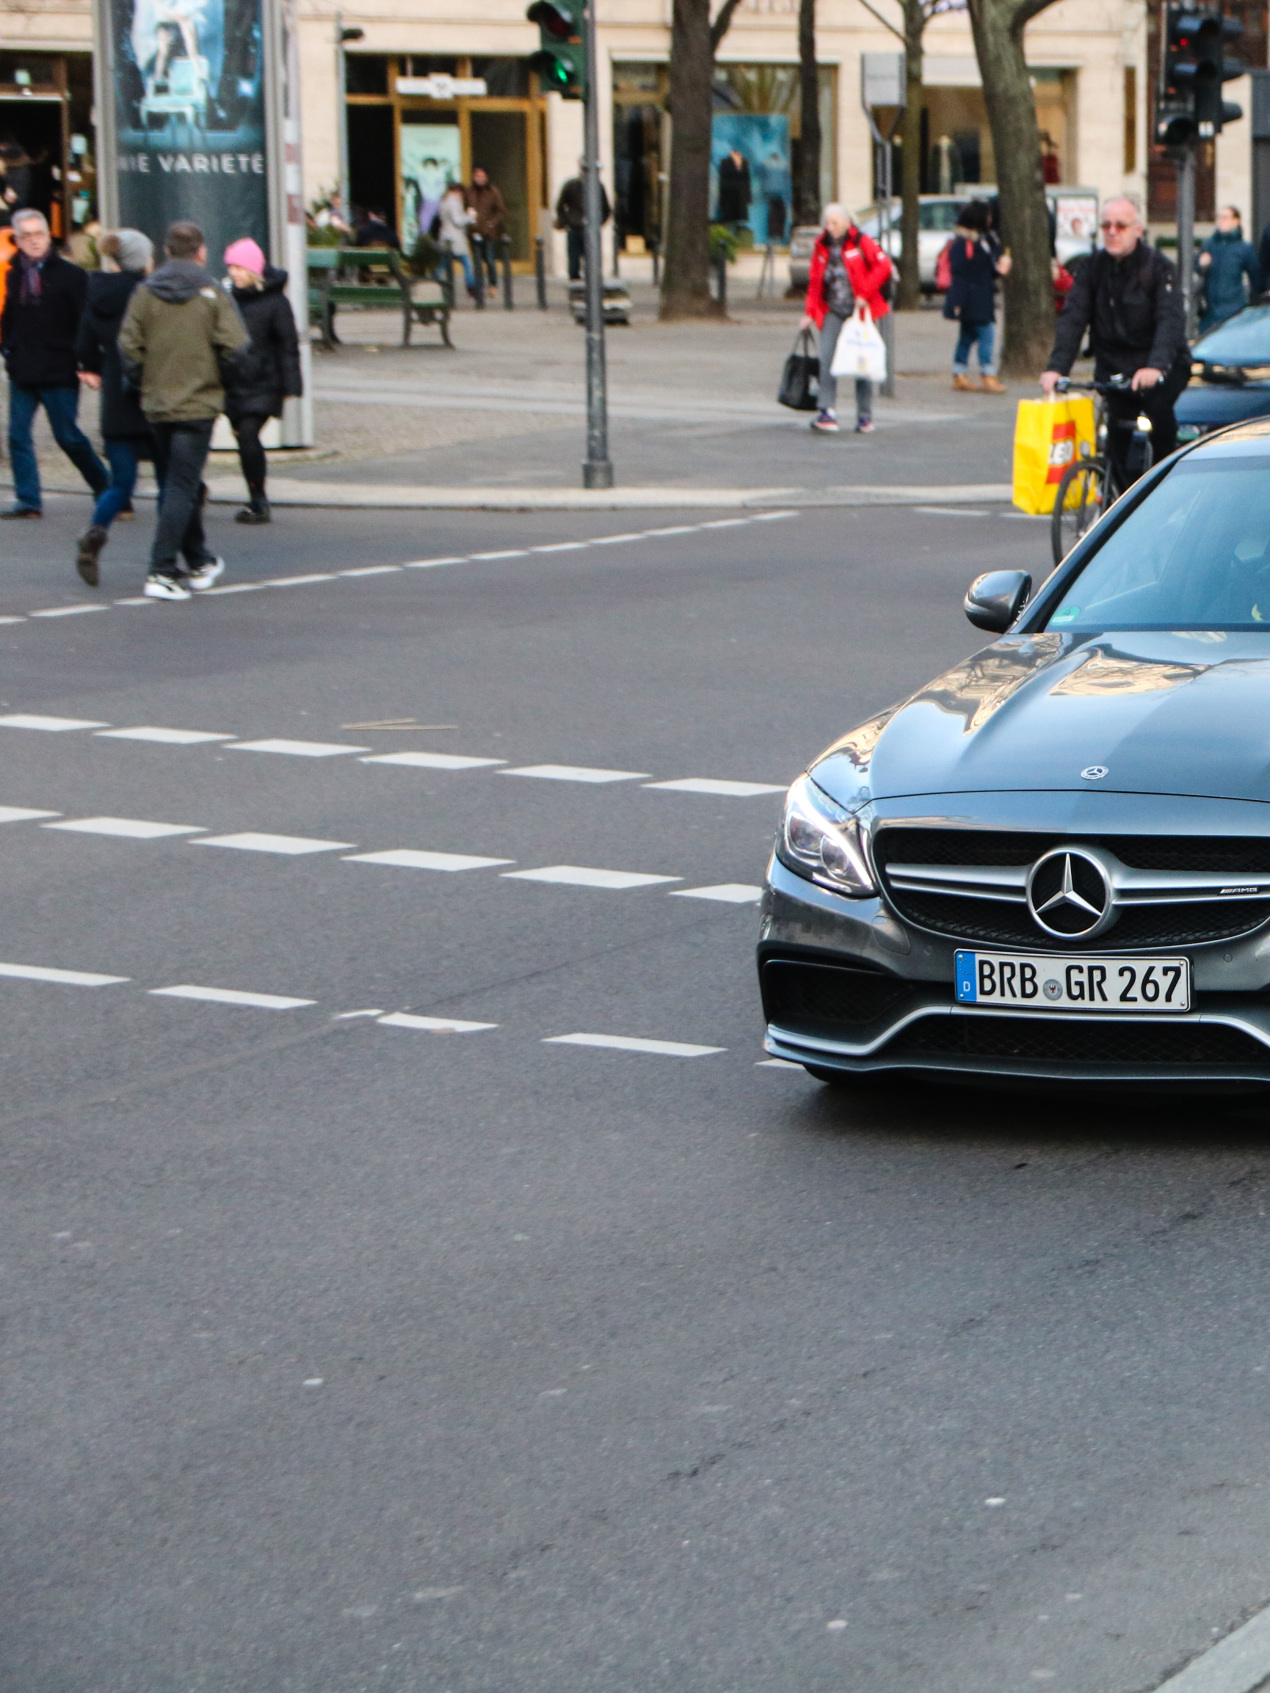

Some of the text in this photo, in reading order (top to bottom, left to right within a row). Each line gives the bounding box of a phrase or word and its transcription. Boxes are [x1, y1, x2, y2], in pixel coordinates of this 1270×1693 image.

[963, 959, 1183, 1003] D BRB GR 267
